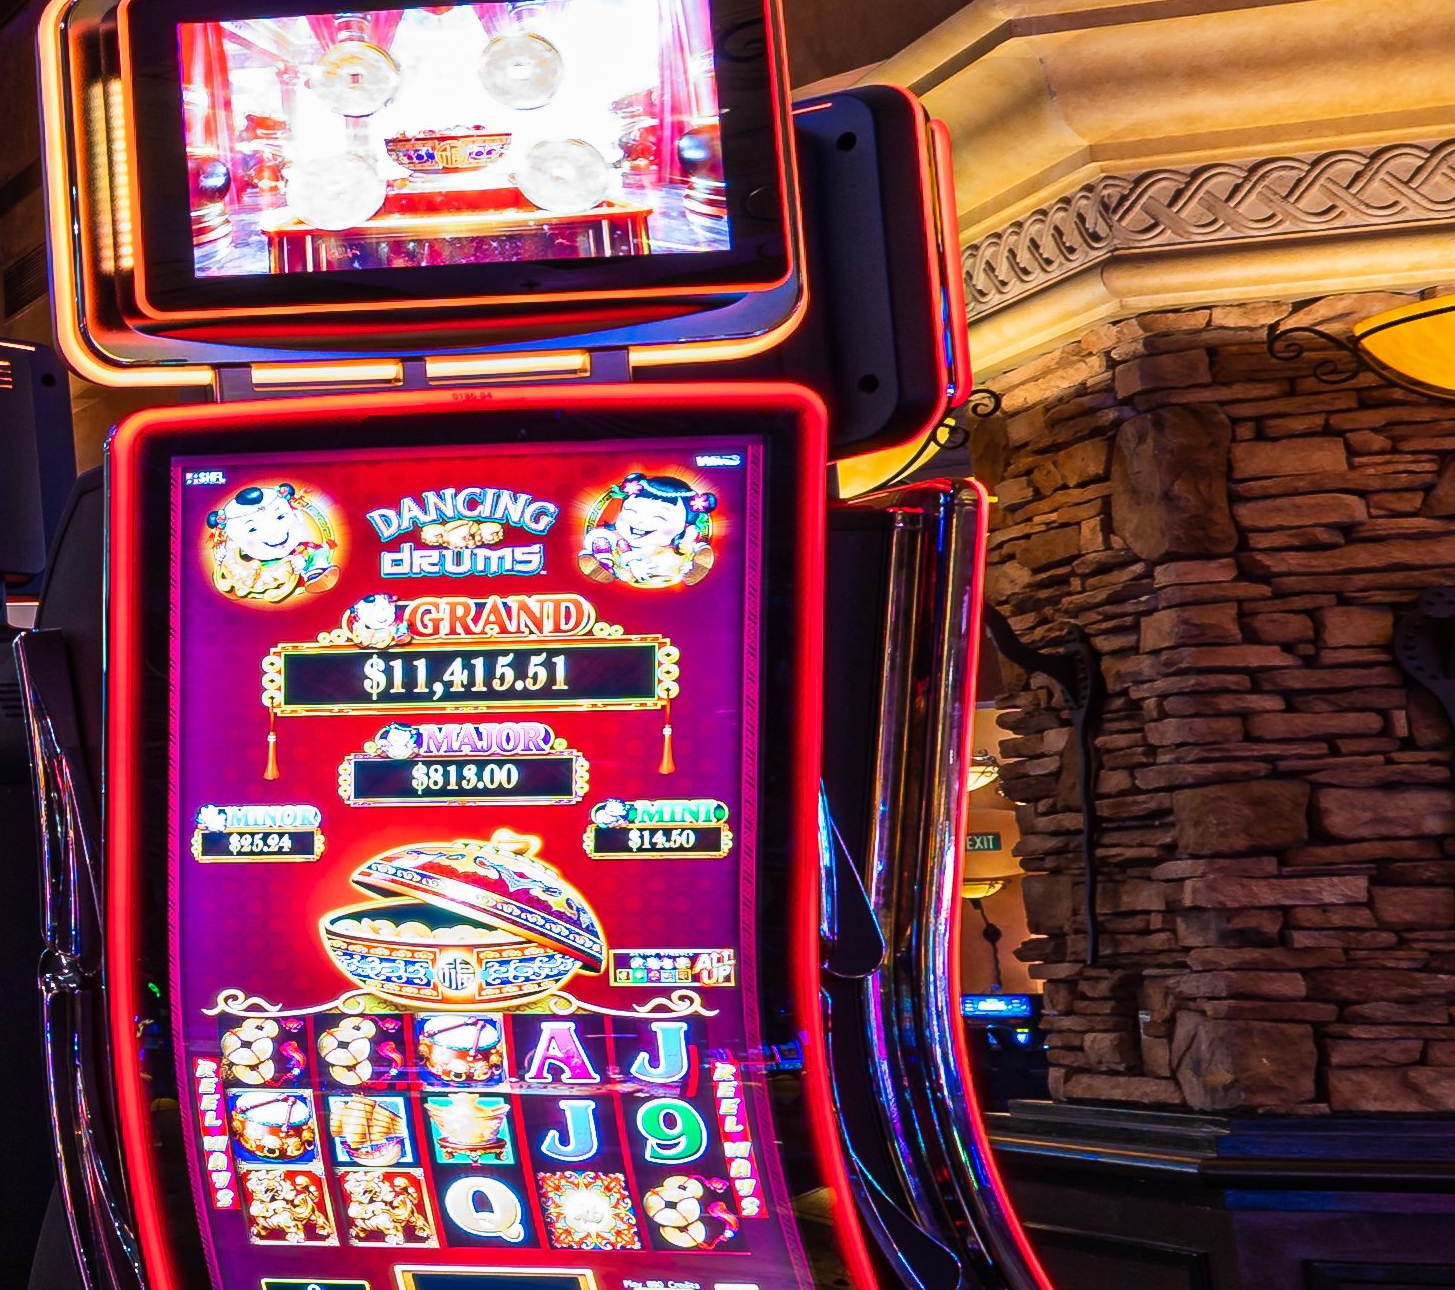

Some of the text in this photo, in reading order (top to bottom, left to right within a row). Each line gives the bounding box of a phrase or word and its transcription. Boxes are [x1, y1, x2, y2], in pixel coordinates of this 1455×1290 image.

[366, 485, 559, 543] DANCING
[406, 595, 588, 639] GRAND
[363, 654, 570, 701] $11,415.51
[419, 724, 549, 754] MAJOR
[226, 807, 321, 829] MINOR
[637, 804, 715, 825] MINI
[628, 829, 696, 850] $14.50
[966, 836, 995, 850] EXIT
[527, 1020, 690, 1083] A J
[195, 1059, 222, 1126] REEL
[541, 1098, 709, 1164] J 9
[445, 1175, 525, 1244] Q
